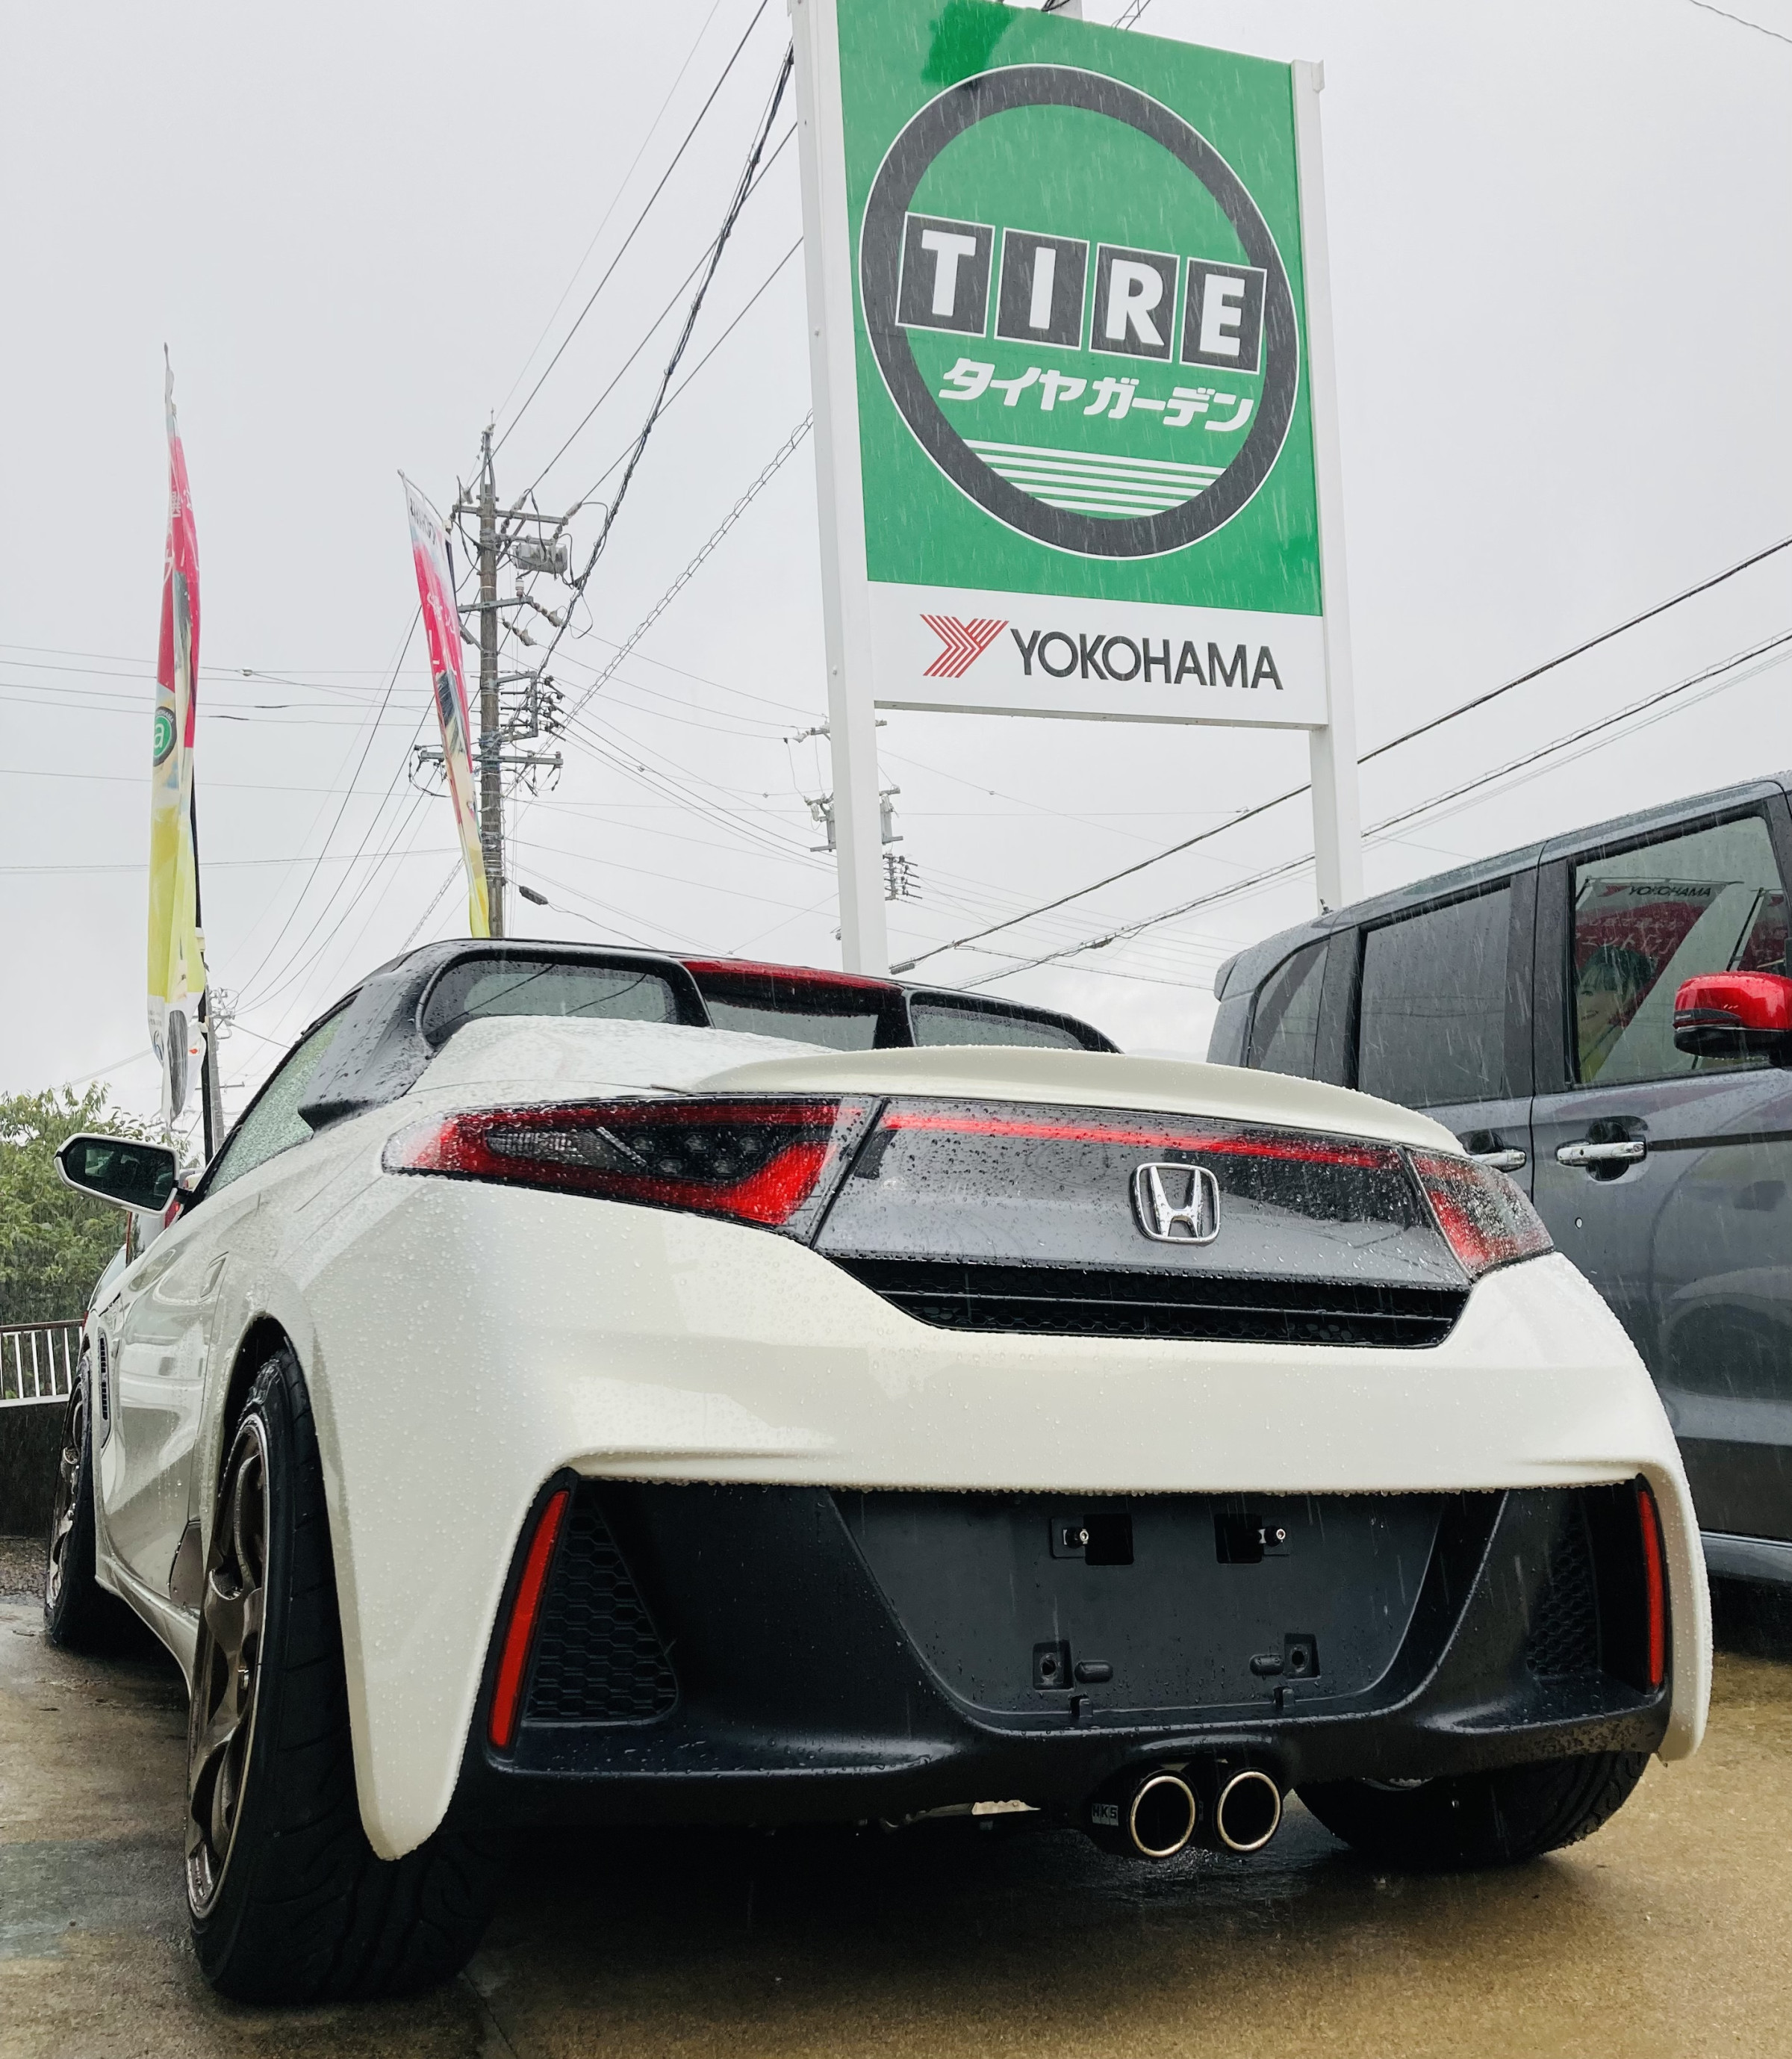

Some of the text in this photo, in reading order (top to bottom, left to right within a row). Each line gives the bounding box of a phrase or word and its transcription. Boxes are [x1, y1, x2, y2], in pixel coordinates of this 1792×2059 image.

[921, 229, 1247, 357] TIRE
[939, 357, 1254, 432] タイヤガーデン
[1010, 627, 1284, 691] YOKOHAMA
[1628, 885, 1711, 897] YOKOHAMA
[1092, 1804, 1118, 1819] HKS
